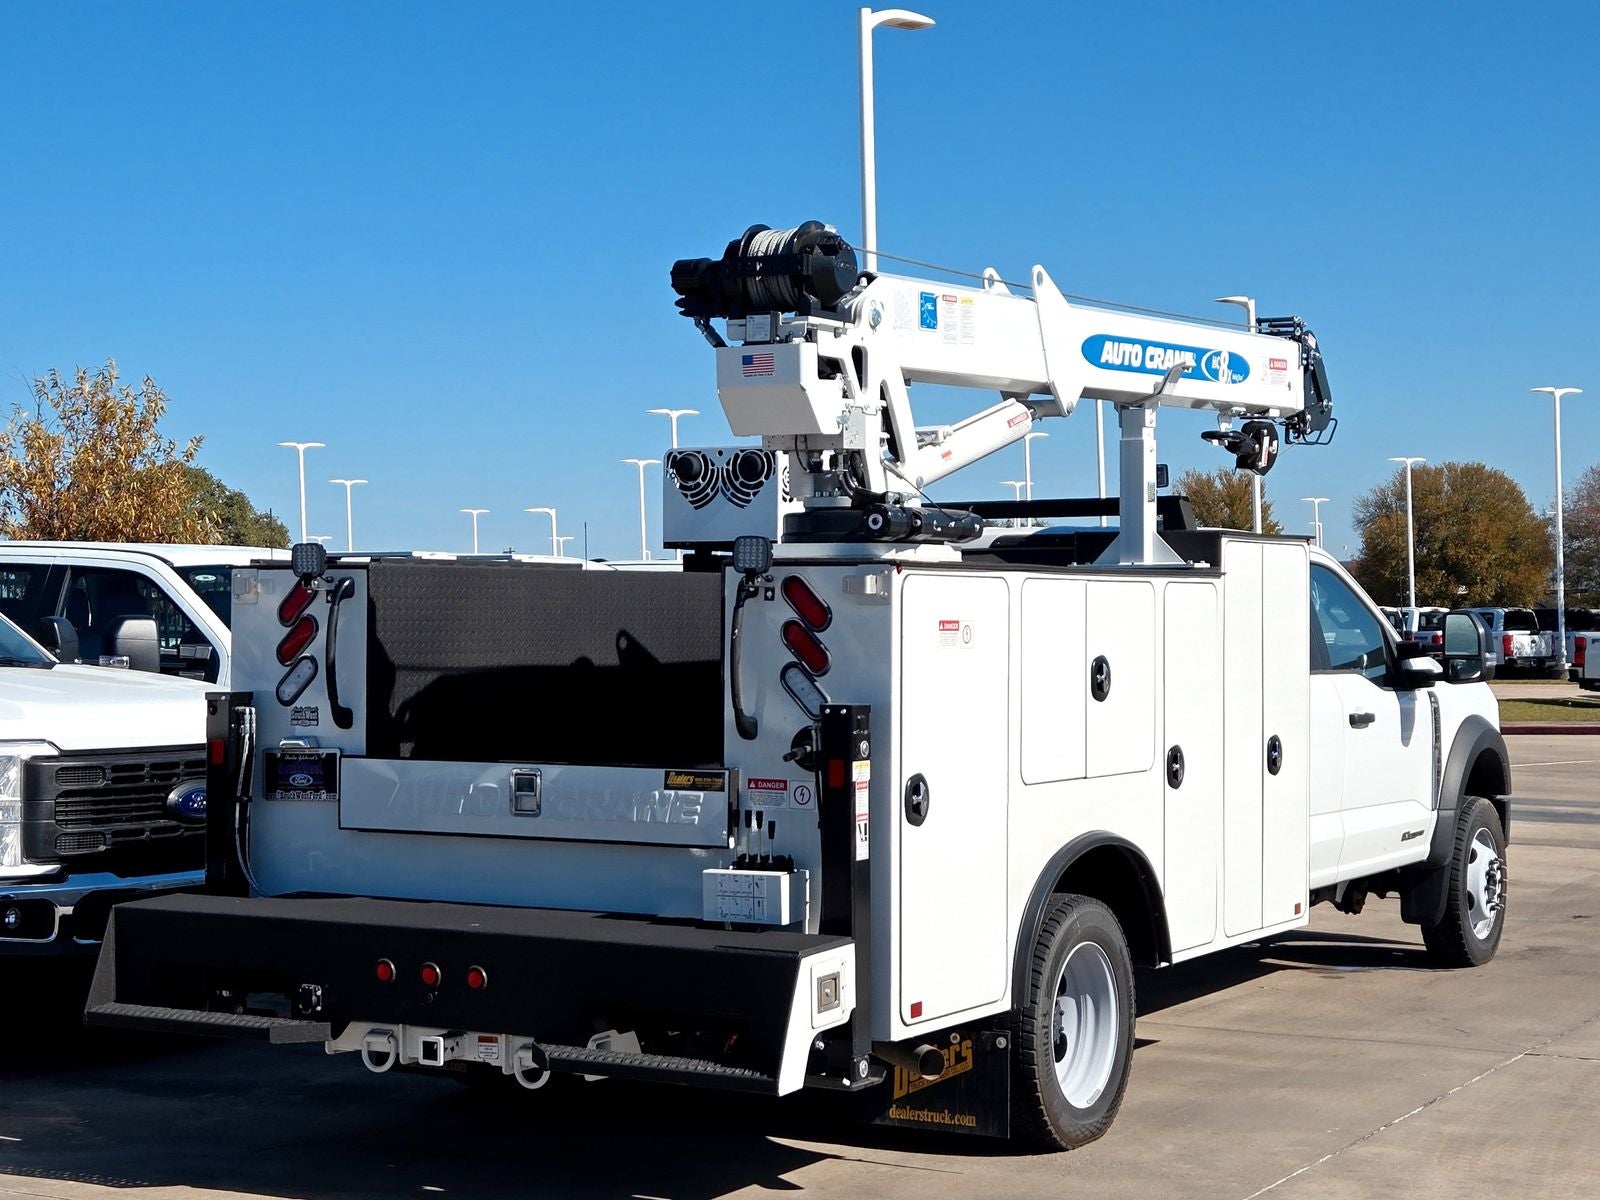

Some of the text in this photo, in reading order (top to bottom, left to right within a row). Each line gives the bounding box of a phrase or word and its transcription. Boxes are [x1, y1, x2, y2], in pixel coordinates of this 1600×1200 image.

[1101, 340, 1143, 368] AUTO
[757, 781, 785, 789] DANGER
[889, 1104, 977, 1127] dealerstruck.com
